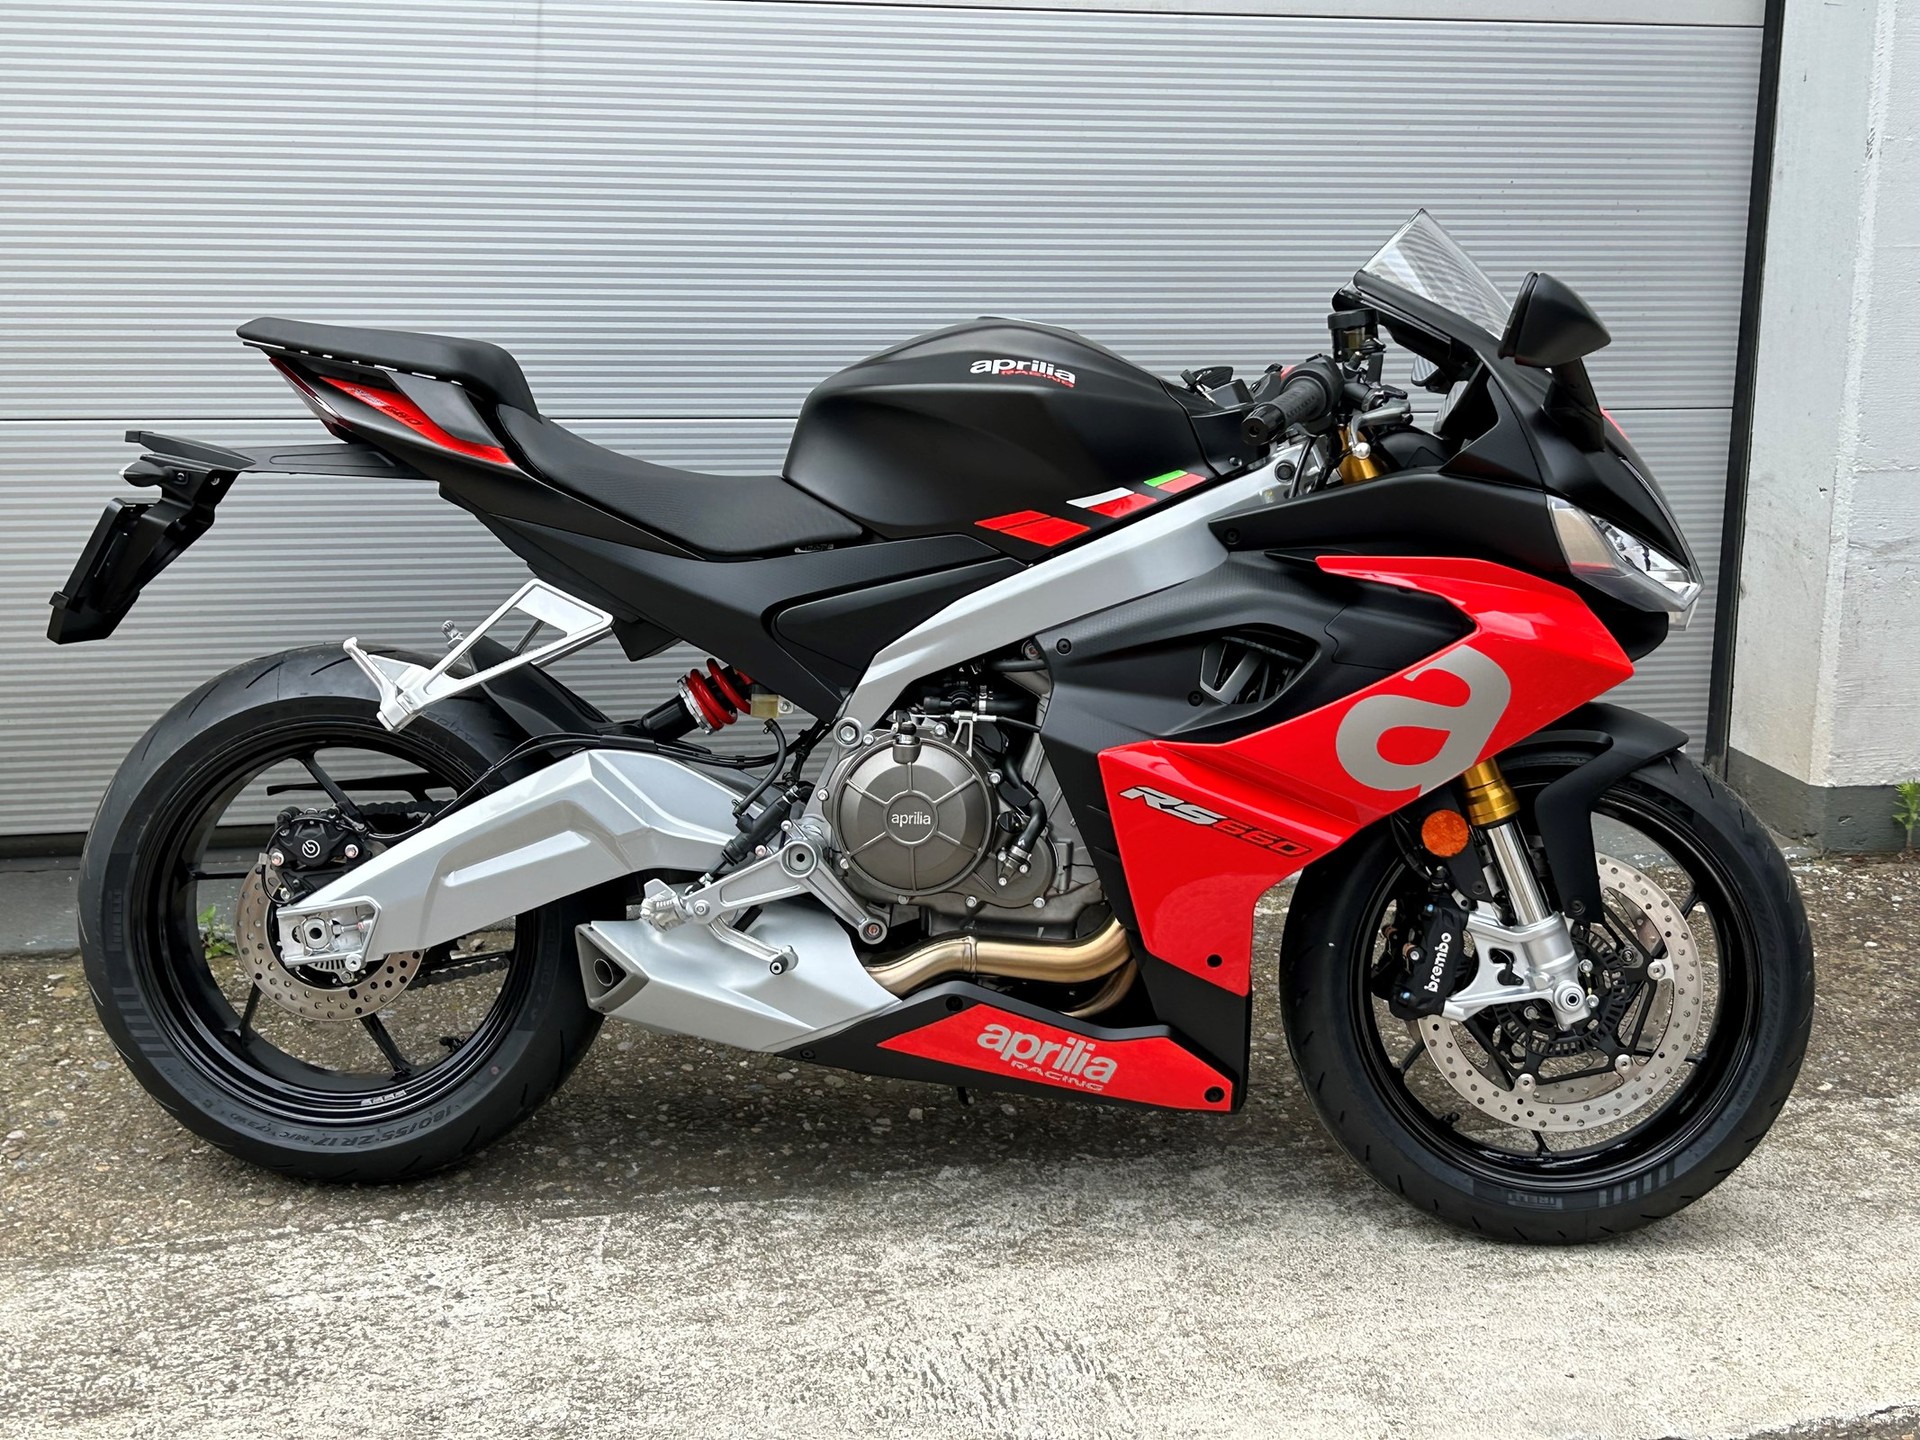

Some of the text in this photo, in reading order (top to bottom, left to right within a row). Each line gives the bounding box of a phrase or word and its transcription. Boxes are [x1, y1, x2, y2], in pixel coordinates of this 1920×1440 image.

[969, 359, 1076, 384] aprilia
[1001, 370, 1075, 387] RACING
[891, 811, 931, 828] aprilia
[1423, 932, 1452, 993] brembo
[976, 1023, 1118, 1084] aprilia
[1010, 1060, 1105, 1092] RACING
